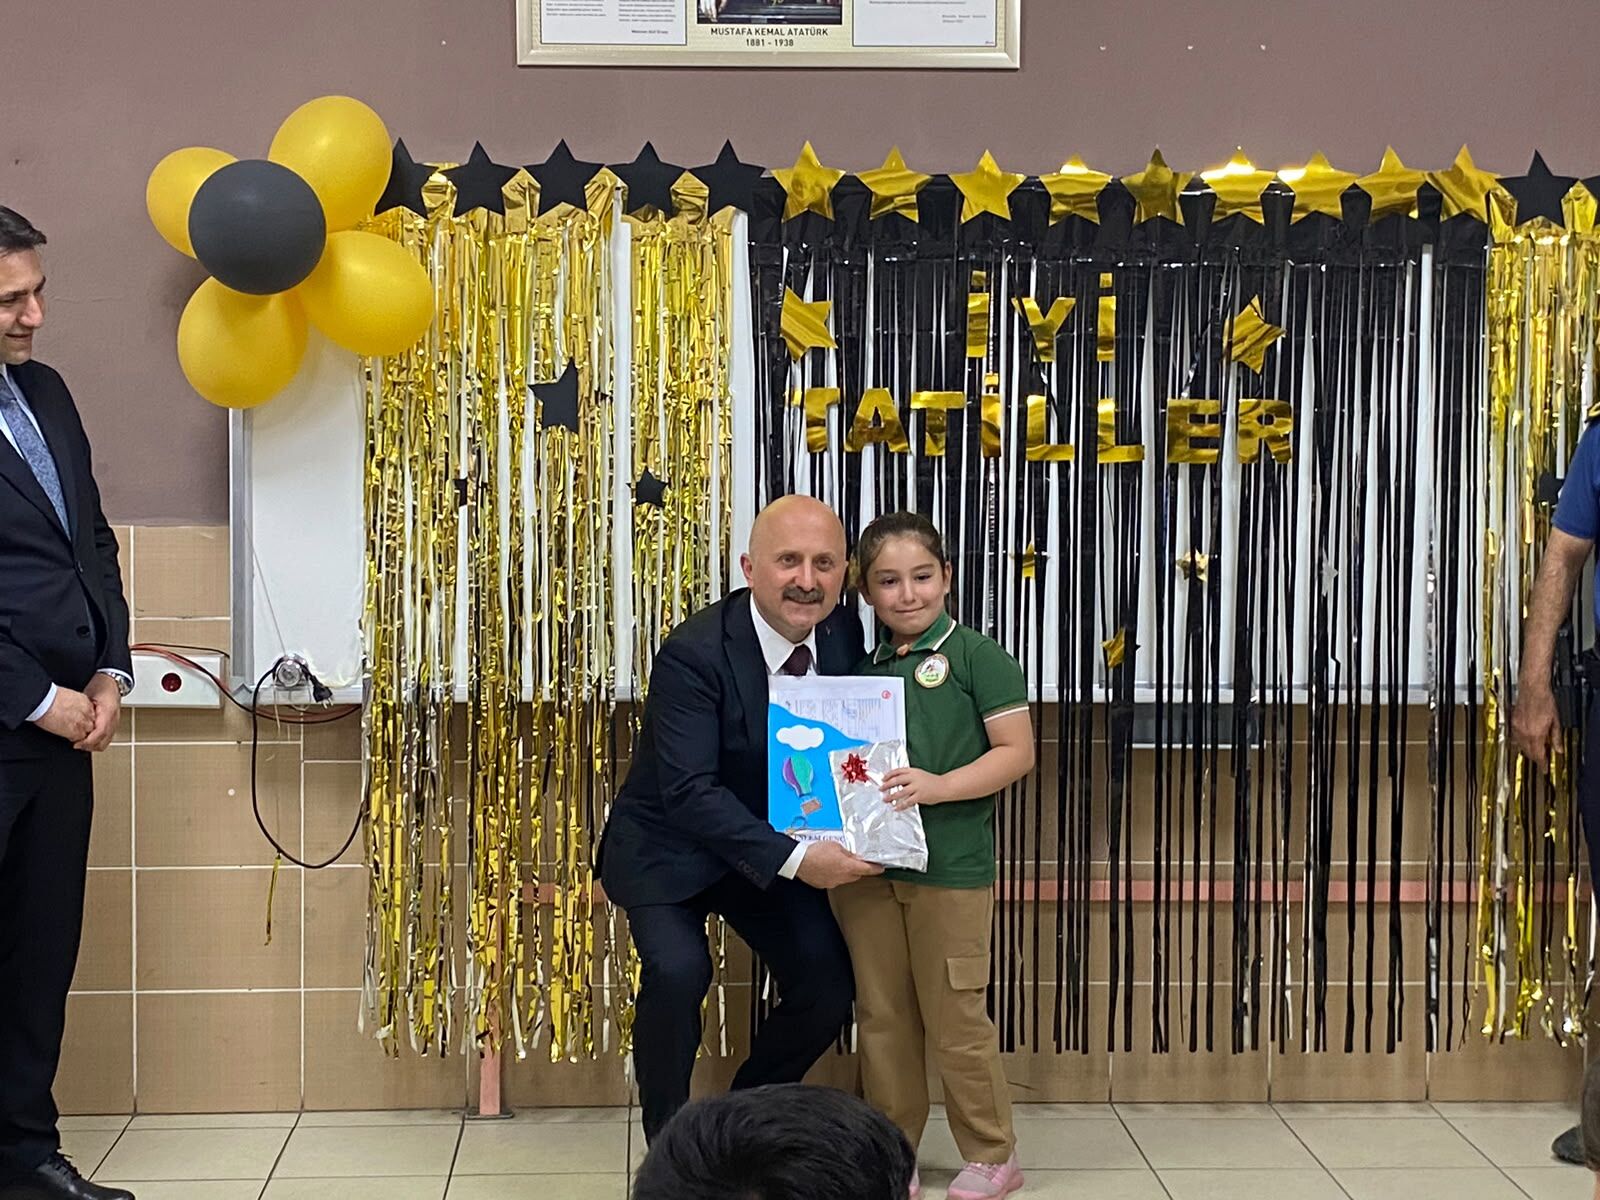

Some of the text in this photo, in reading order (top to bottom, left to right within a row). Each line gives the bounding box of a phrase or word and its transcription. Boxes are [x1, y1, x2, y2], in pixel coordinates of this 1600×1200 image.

[710, 26, 829, 36] MUSTAFA KEMAL ATATÜRK
[746, 38, 765, 47] 1881
[774, 38, 794, 47] 1938
[785, 373, 1294, 465] TATİLLER
